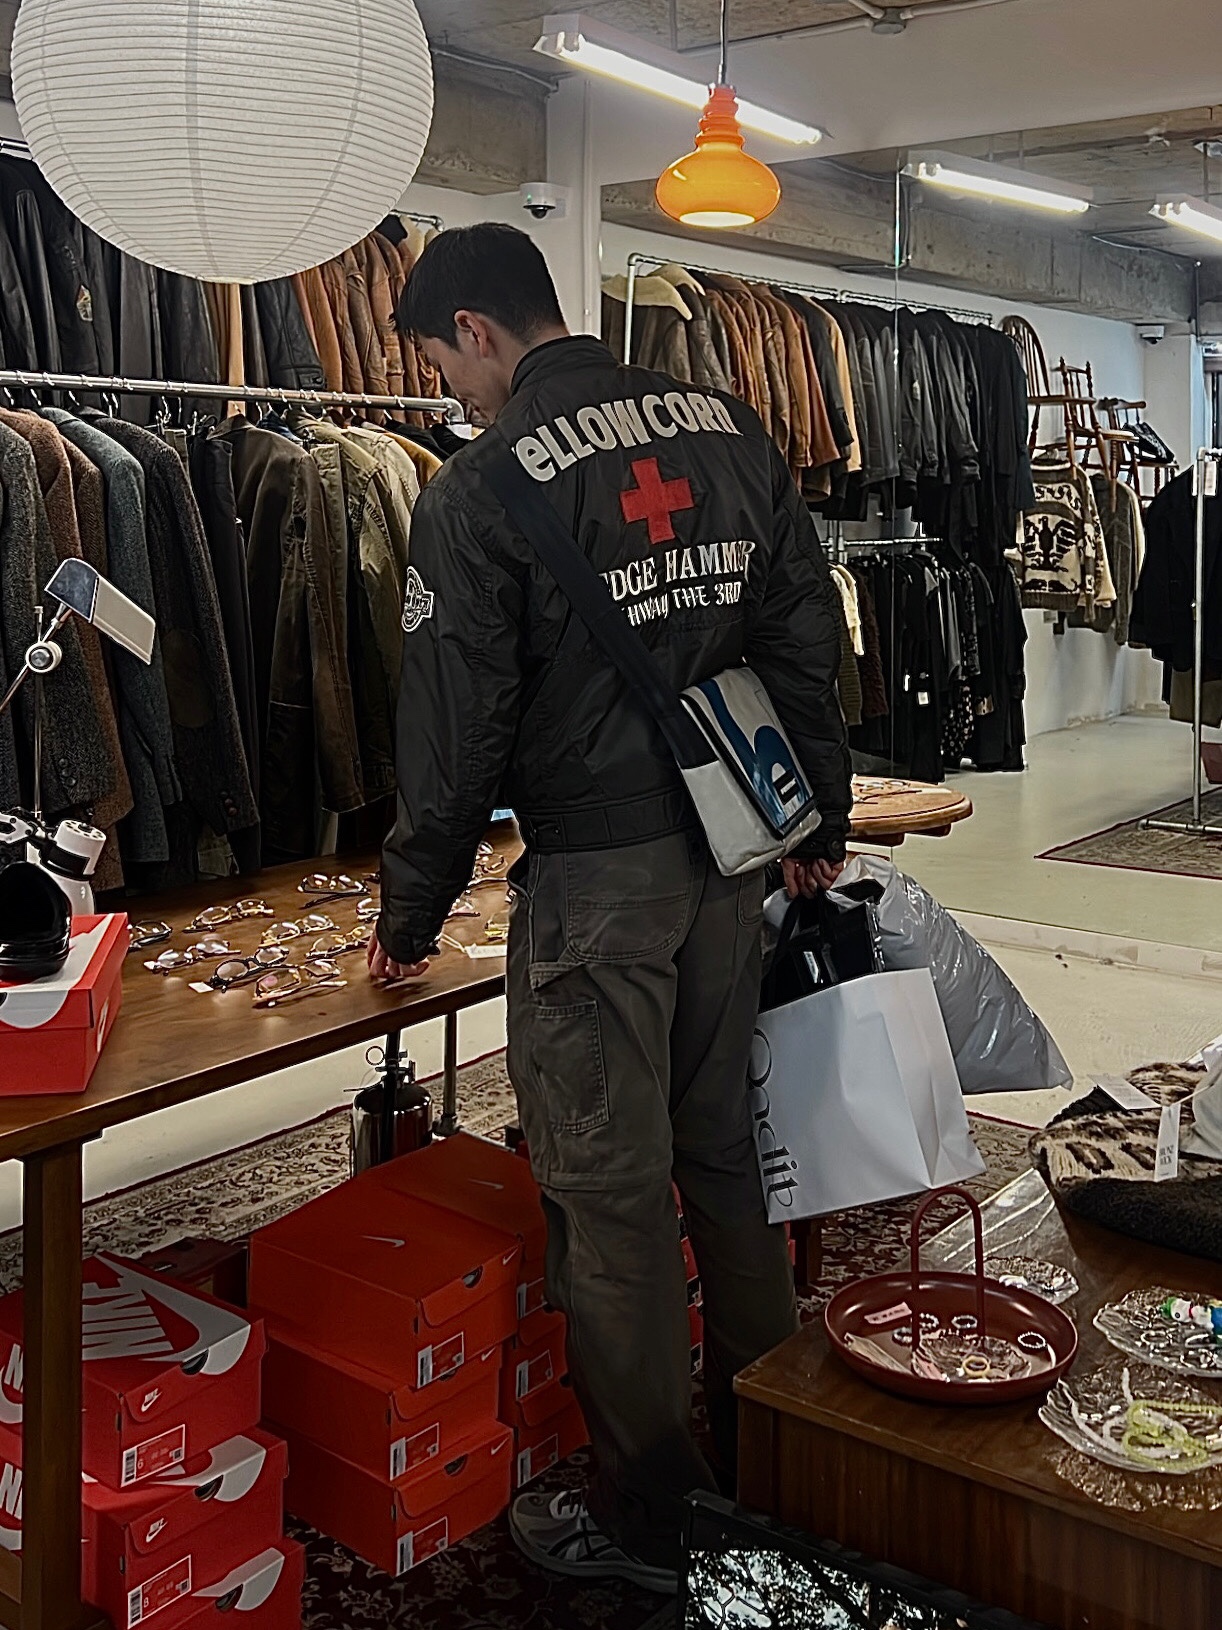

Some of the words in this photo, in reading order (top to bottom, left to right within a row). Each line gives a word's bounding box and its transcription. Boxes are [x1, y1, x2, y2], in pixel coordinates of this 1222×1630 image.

[599, 557, 658, 601] DGE
[671, 585, 711, 609] THE
[714, 581, 742, 605] 3RD
